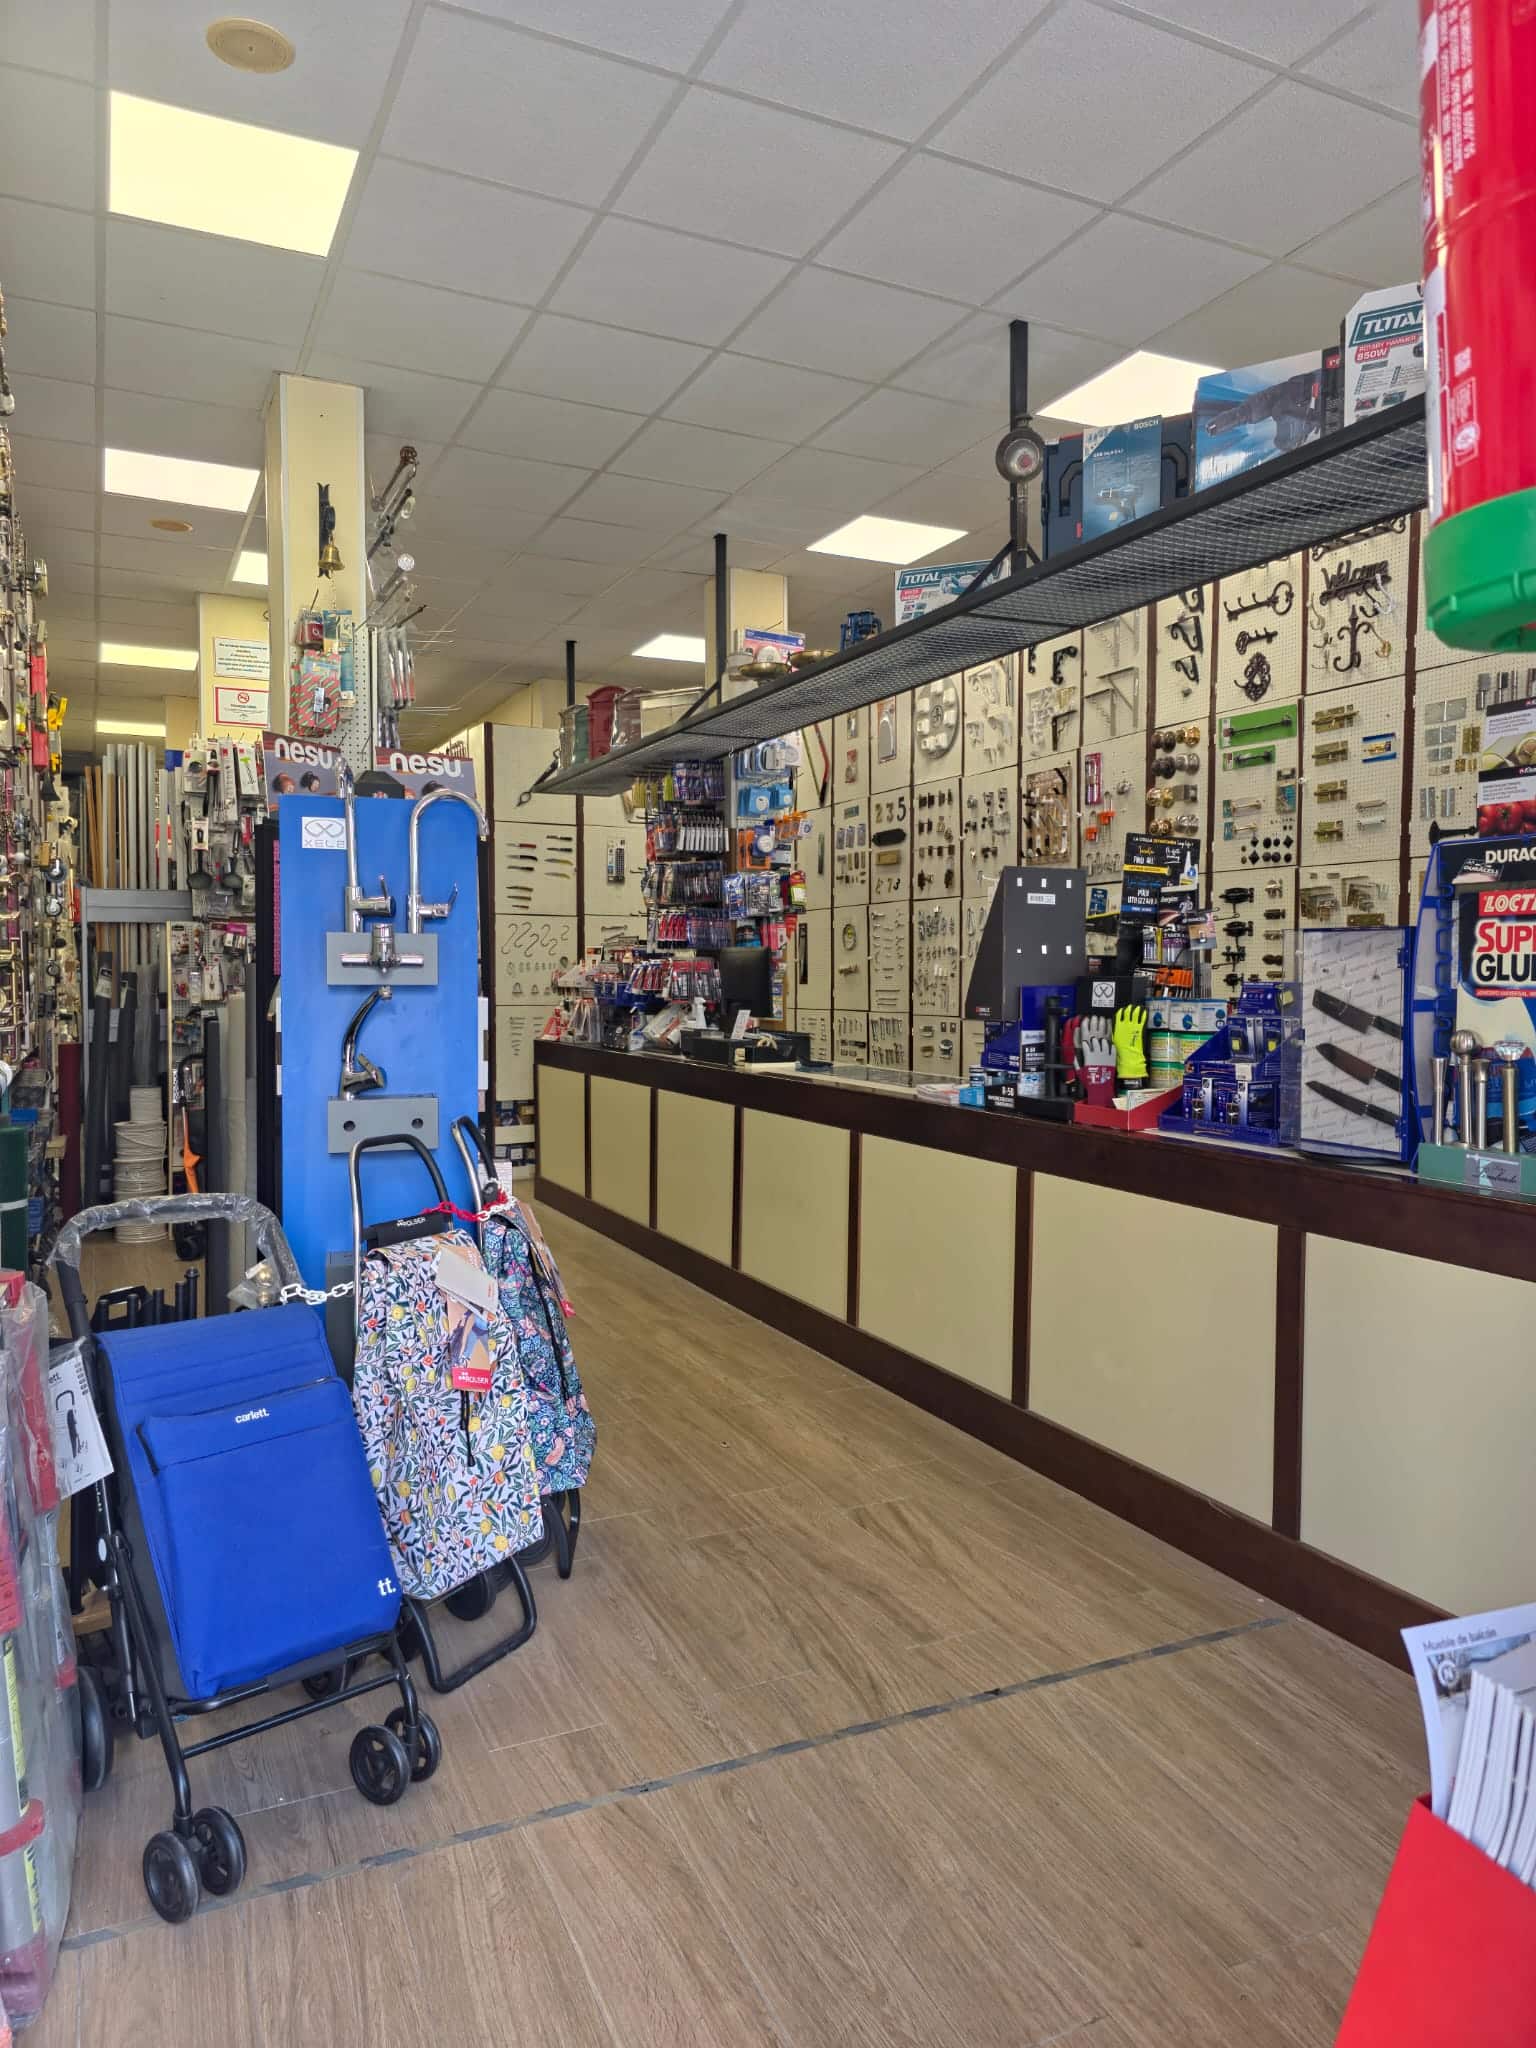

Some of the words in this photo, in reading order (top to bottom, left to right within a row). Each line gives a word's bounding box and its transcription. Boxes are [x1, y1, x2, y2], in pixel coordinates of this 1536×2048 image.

[1134, 420, 1159, 430] BOSCH
[904, 572, 941, 585] TOTAL
[274, 737, 334, 769] nesu
[390, 752, 462, 778] nesu
[235, 1408, 270, 1424] carlett.
